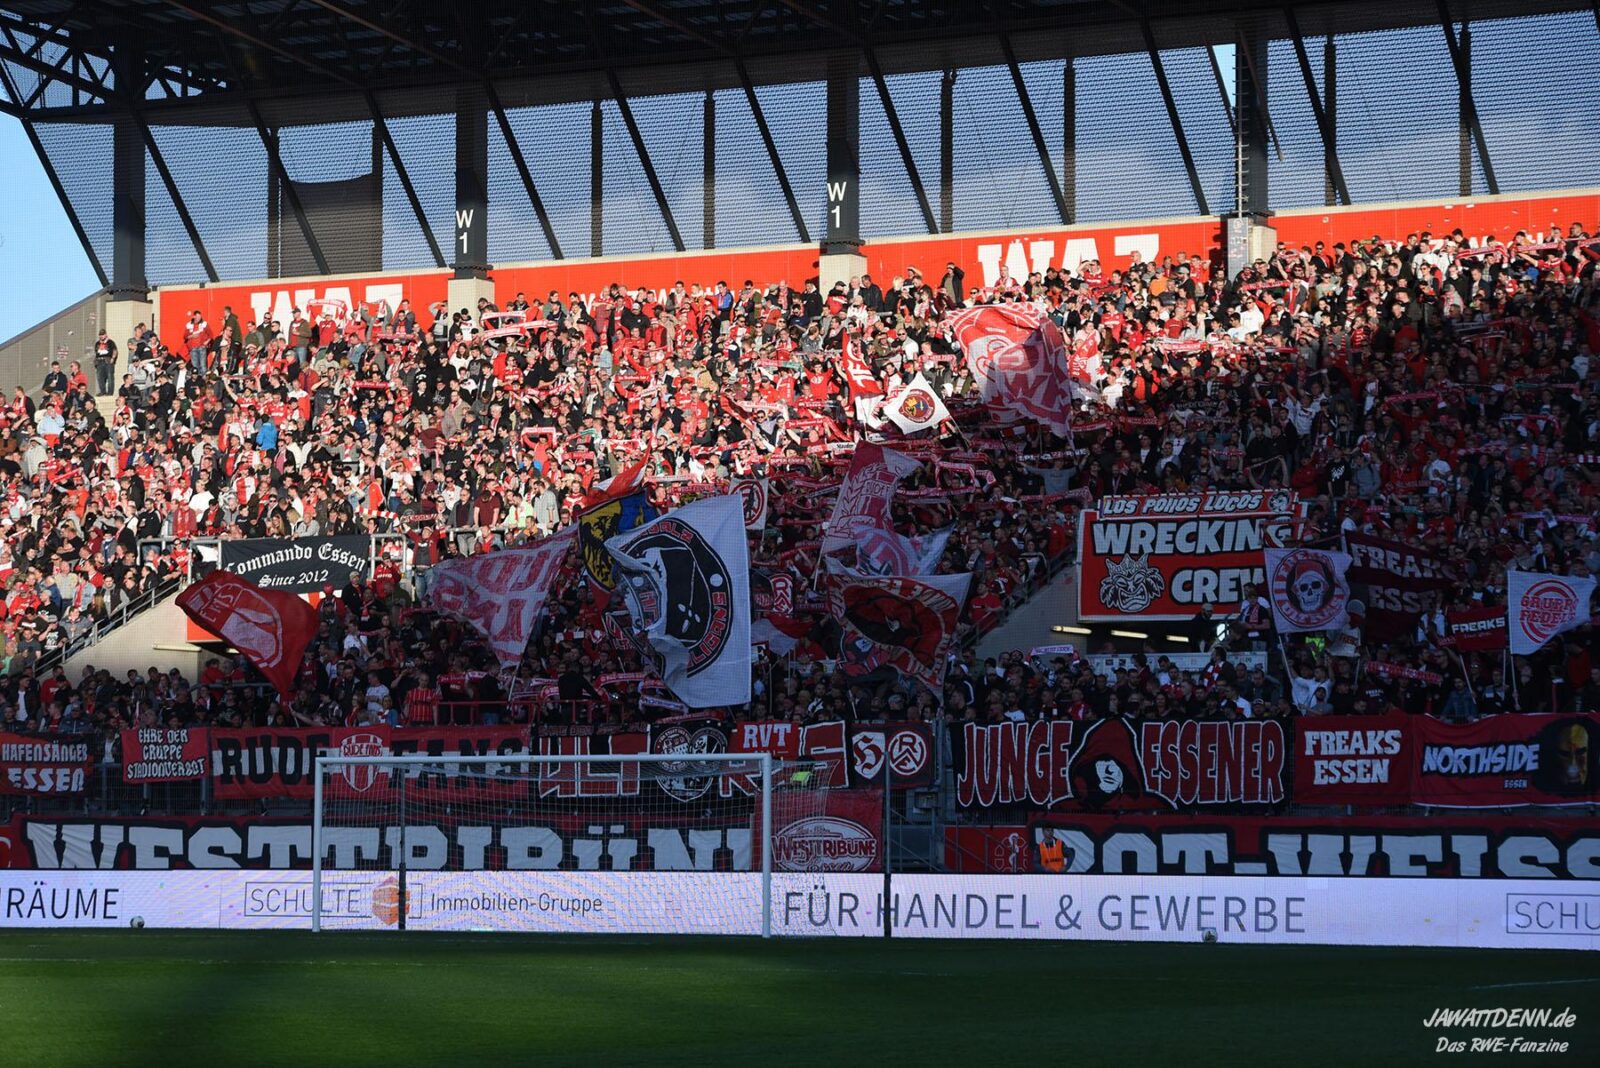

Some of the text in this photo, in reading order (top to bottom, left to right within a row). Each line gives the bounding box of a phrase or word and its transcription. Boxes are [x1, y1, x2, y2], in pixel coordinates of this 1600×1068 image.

[827, 182, 847, 201] W
[455, 209, 474, 229] W
[830, 204, 842, 228] 1
[458, 231, 468, 254] 1
[1103, 498, 1138, 515] LOS
[1203, 494, 1263, 512] LOCOS
[318, 542, 366, 572] Essen
[258, 569, 329, 588] Since 2012
[1367, 584, 1446, 613] ESSE
[1451, 617, 1505, 634] FREAKS
[138, 728, 188, 743] EHRE DER
[743, 723, 791, 749] RVT
[1304, 730, 1402, 756] FREAKS
[143, 745, 182, 760] GRUPPE
[217, 735, 331, 786] RUDE
[538, 720, 849, 799] ULTRS
[957, 720, 1285, 807] JUNGE ESSENER
[1422, 744, 1541, 776] NORTHSIDE
[8, 768, 84, 792] ESSEN
[127, 758, 205, 779] STADIONVERBOT
[1313, 759, 1391, 786] ESSEN
[771, 836, 877, 865] WESTTRIBÜNE
[250, 888, 361, 914] SCHULTE
[431, 893, 603, 917] Immobilien-Gruppe
[784, 884, 1306, 933] FÜR HANDEL & GEWERBE
